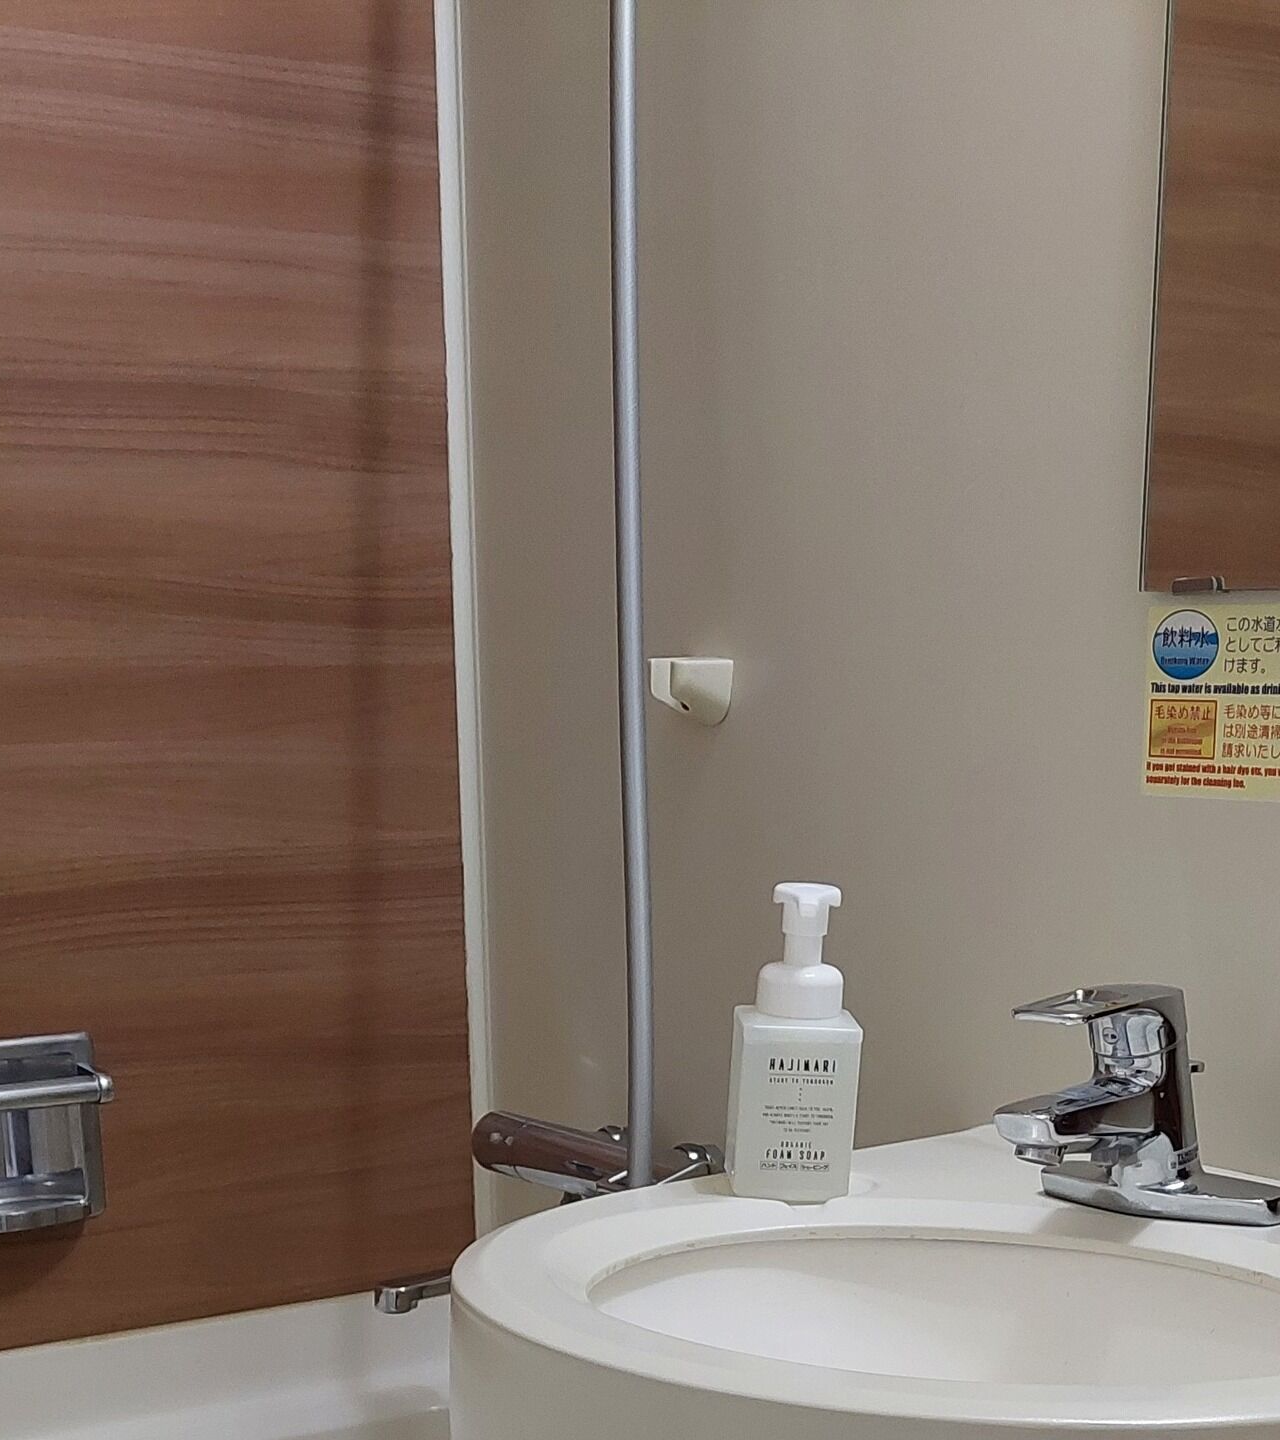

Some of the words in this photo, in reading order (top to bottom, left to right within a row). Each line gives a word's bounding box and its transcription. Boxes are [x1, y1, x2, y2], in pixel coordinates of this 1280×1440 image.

[1162, 626, 1209, 648] 飲料水
[1223, 657, 1266, 674] けます。
[1151, 682, 1166, 693] This
[1168, 683, 1180, 694] tap
[1181, 683, 1203, 694] water
[1204, 682, 1212, 694] is
[1213, 683, 1249, 694] available
[1250, 685, 1260, 695] as
[1154, 704, 1212, 721] 毛染め禁止
[1152, 763, 1163, 772] you
[1176, 763, 1200, 772] stained
[1202, 764, 1216, 773] with
[1222, 764, 1236, 774] hair
[1264, 767, 1277, 777] you
[1191, 777, 1201, 786] the
[1203, 777, 1232, 788] cleaning
[769, 1058, 836, 1073] HAJIMARI
[766, 1148, 792, 1159] FOAM
[799, 1150, 825, 1160] SOAP
